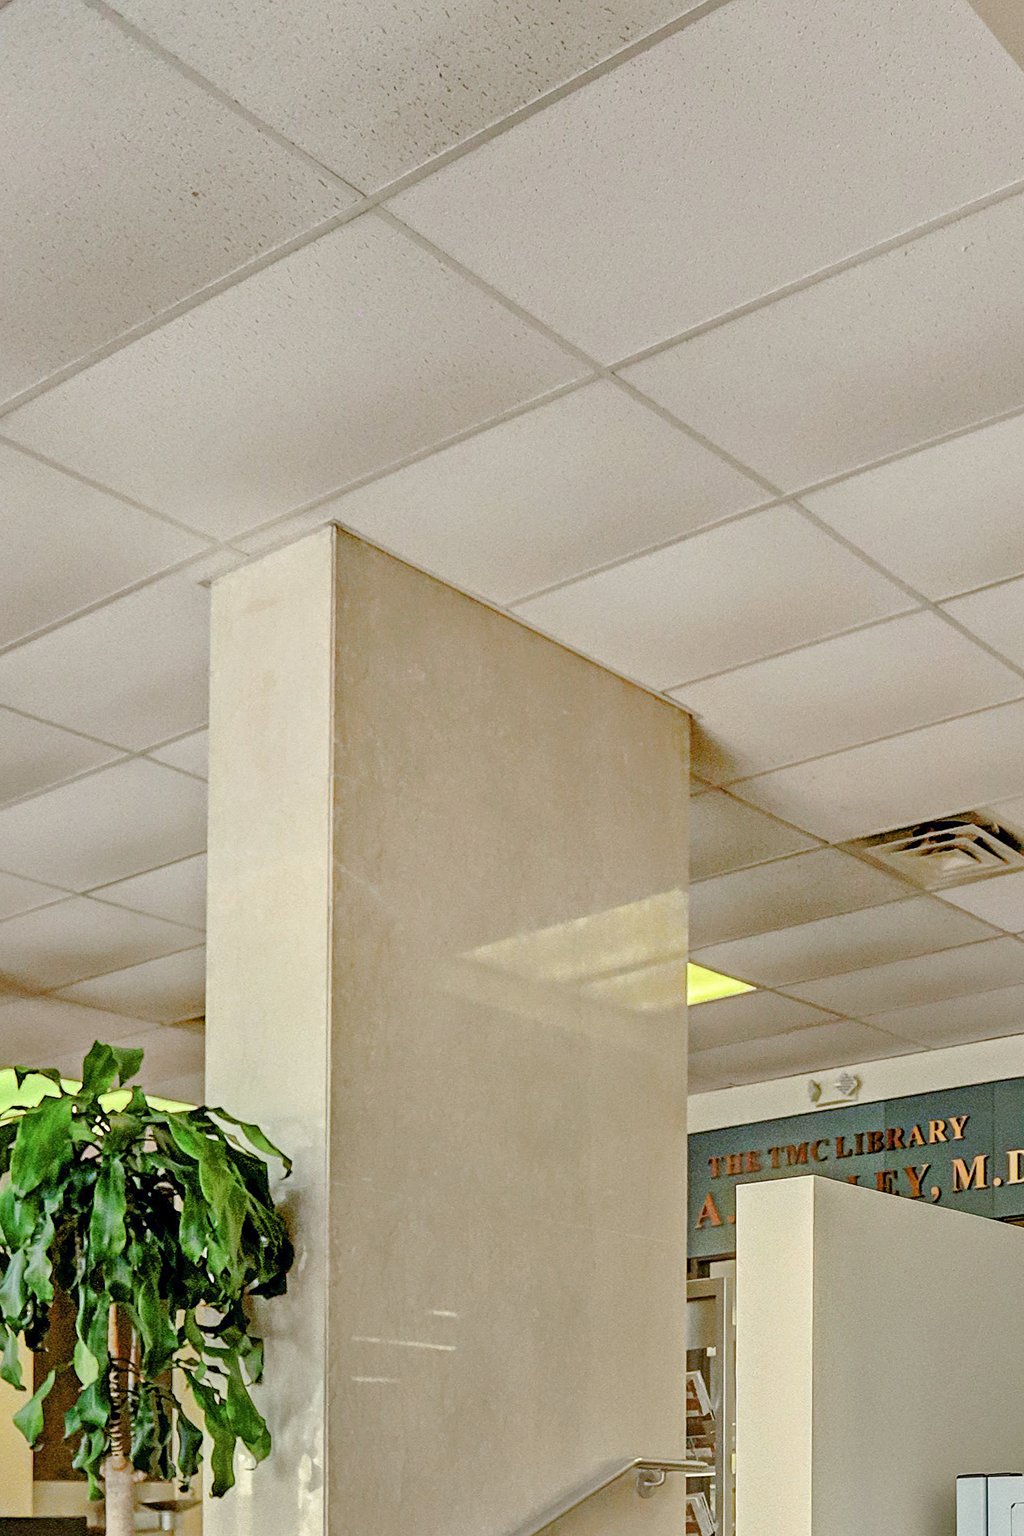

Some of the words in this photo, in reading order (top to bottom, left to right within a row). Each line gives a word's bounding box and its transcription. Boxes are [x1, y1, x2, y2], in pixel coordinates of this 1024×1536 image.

[707, 1151, 763, 1180] THE
[767, 1139, 830, 1169] TMC
[834, 1114, 970, 1160] LIBRARY
